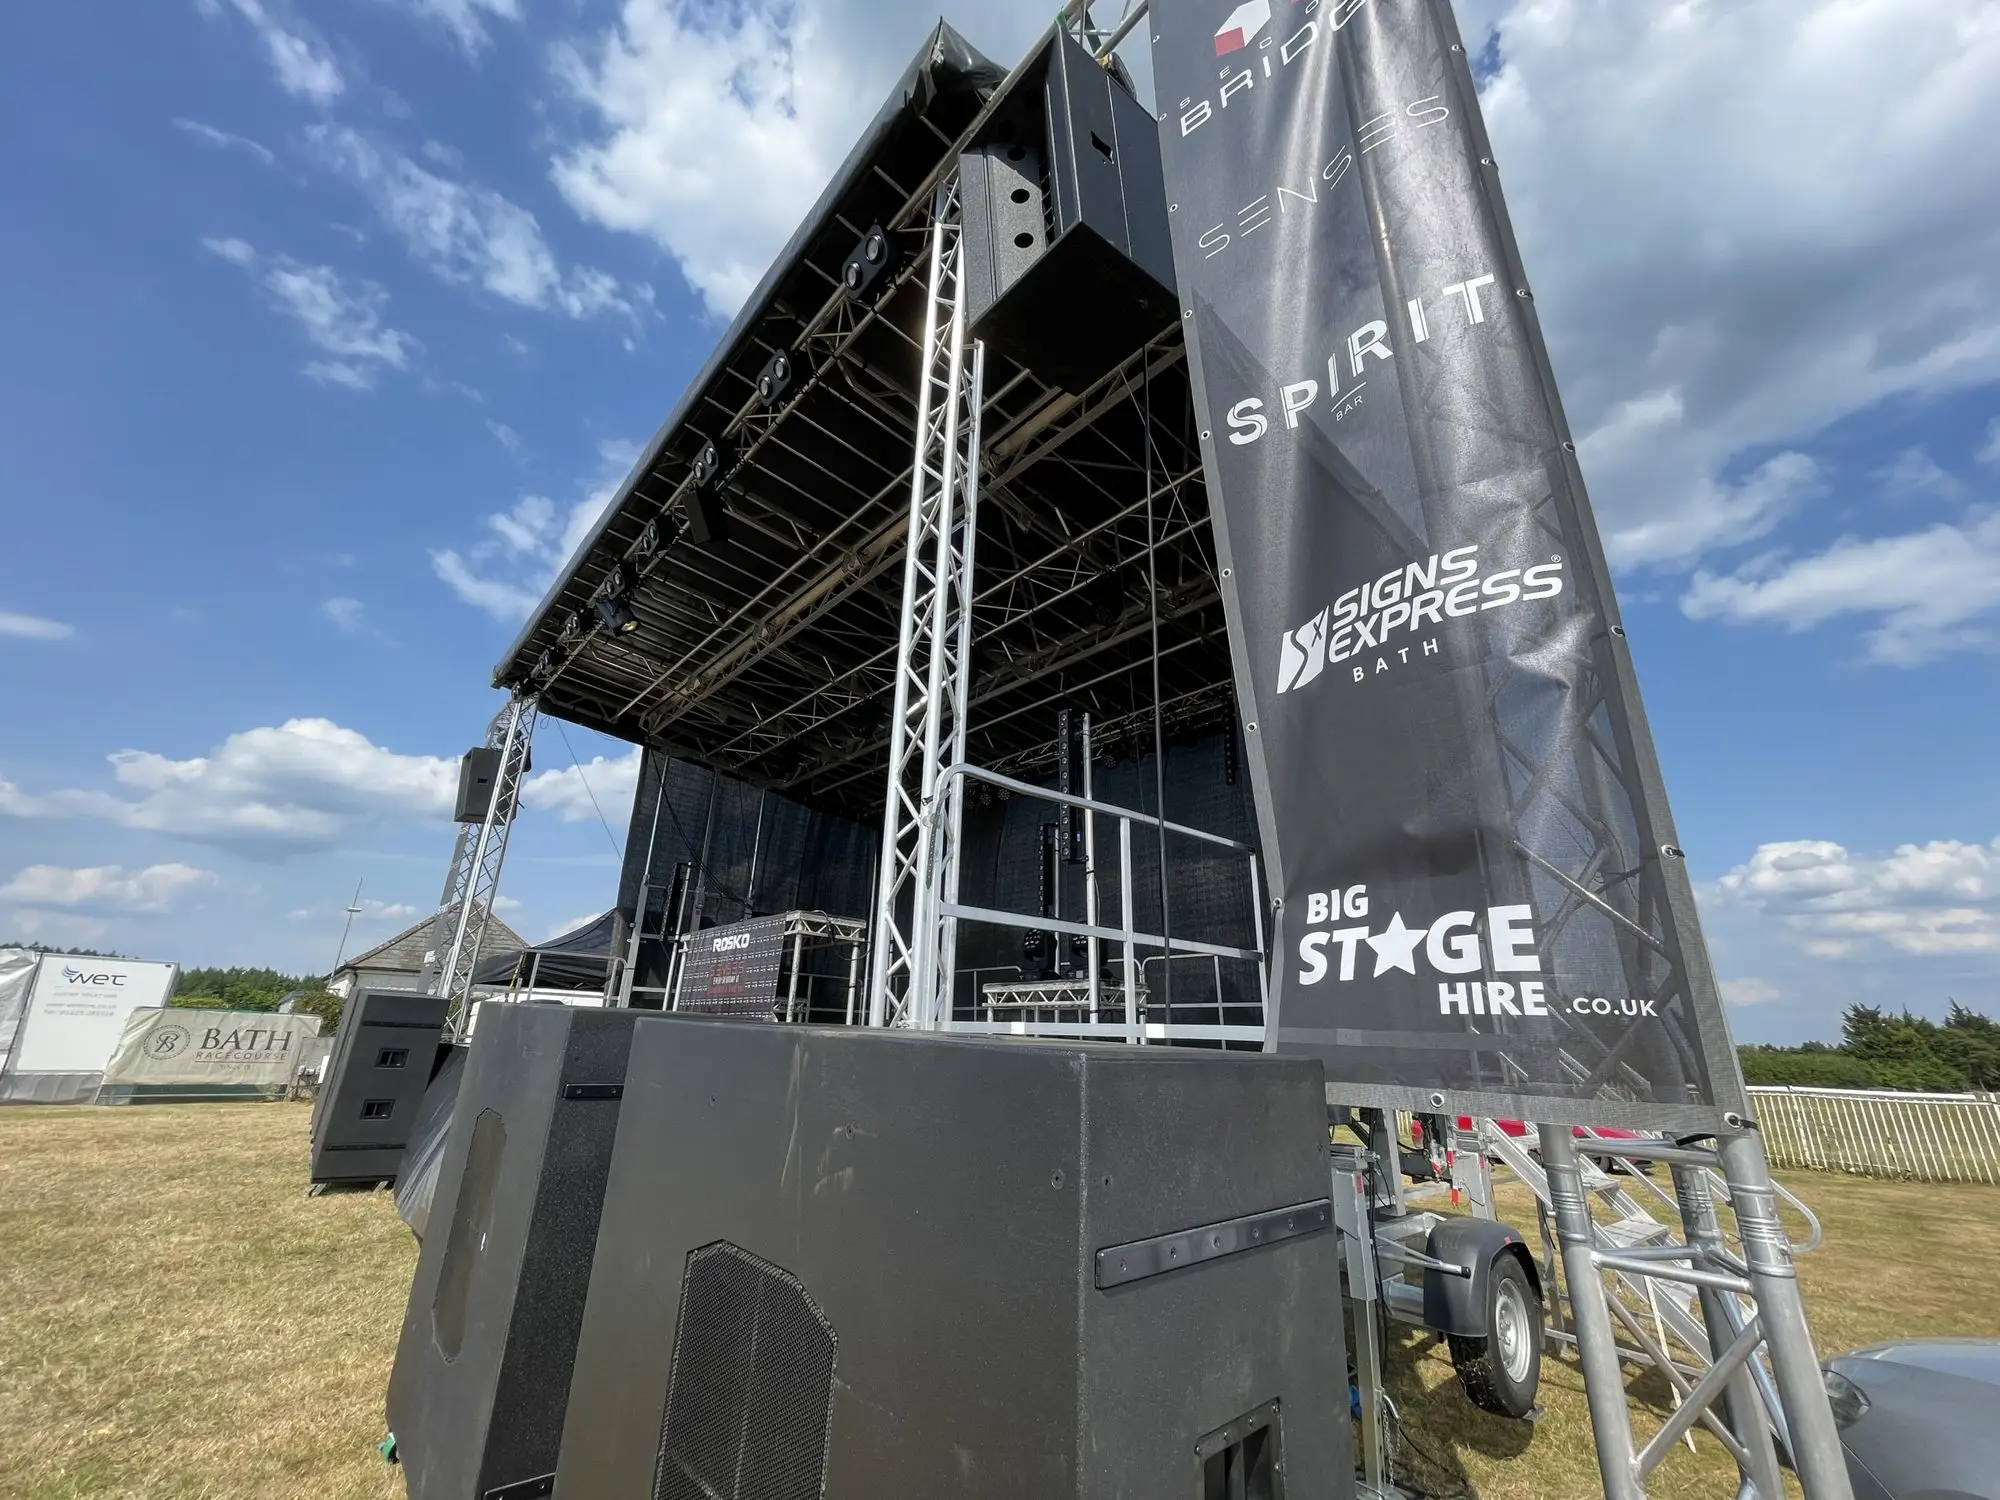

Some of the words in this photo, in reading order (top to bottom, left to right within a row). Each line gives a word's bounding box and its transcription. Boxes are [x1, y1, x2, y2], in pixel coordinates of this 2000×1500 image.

[1198, 95, 1450, 259] SENSES
[1226, 273, 1495, 446] SPIRIT
[1335, 394, 1364, 422] BAR
[1333, 545, 1478, 624] SIGNS
[1328, 563, 1563, 663] EXPRESS
[1353, 639, 1439, 683] BATH
[1306, 884, 1368, 925] BIG
[712, 933, 750, 952] ROSKO
[1439, 981, 1548, 1017] HIRE
[1564, 997, 1658, 1018] .CO.UK
[195, 1051, 287, 1061] RACECOURSE
[200, 1028, 293, 1051] BATH
